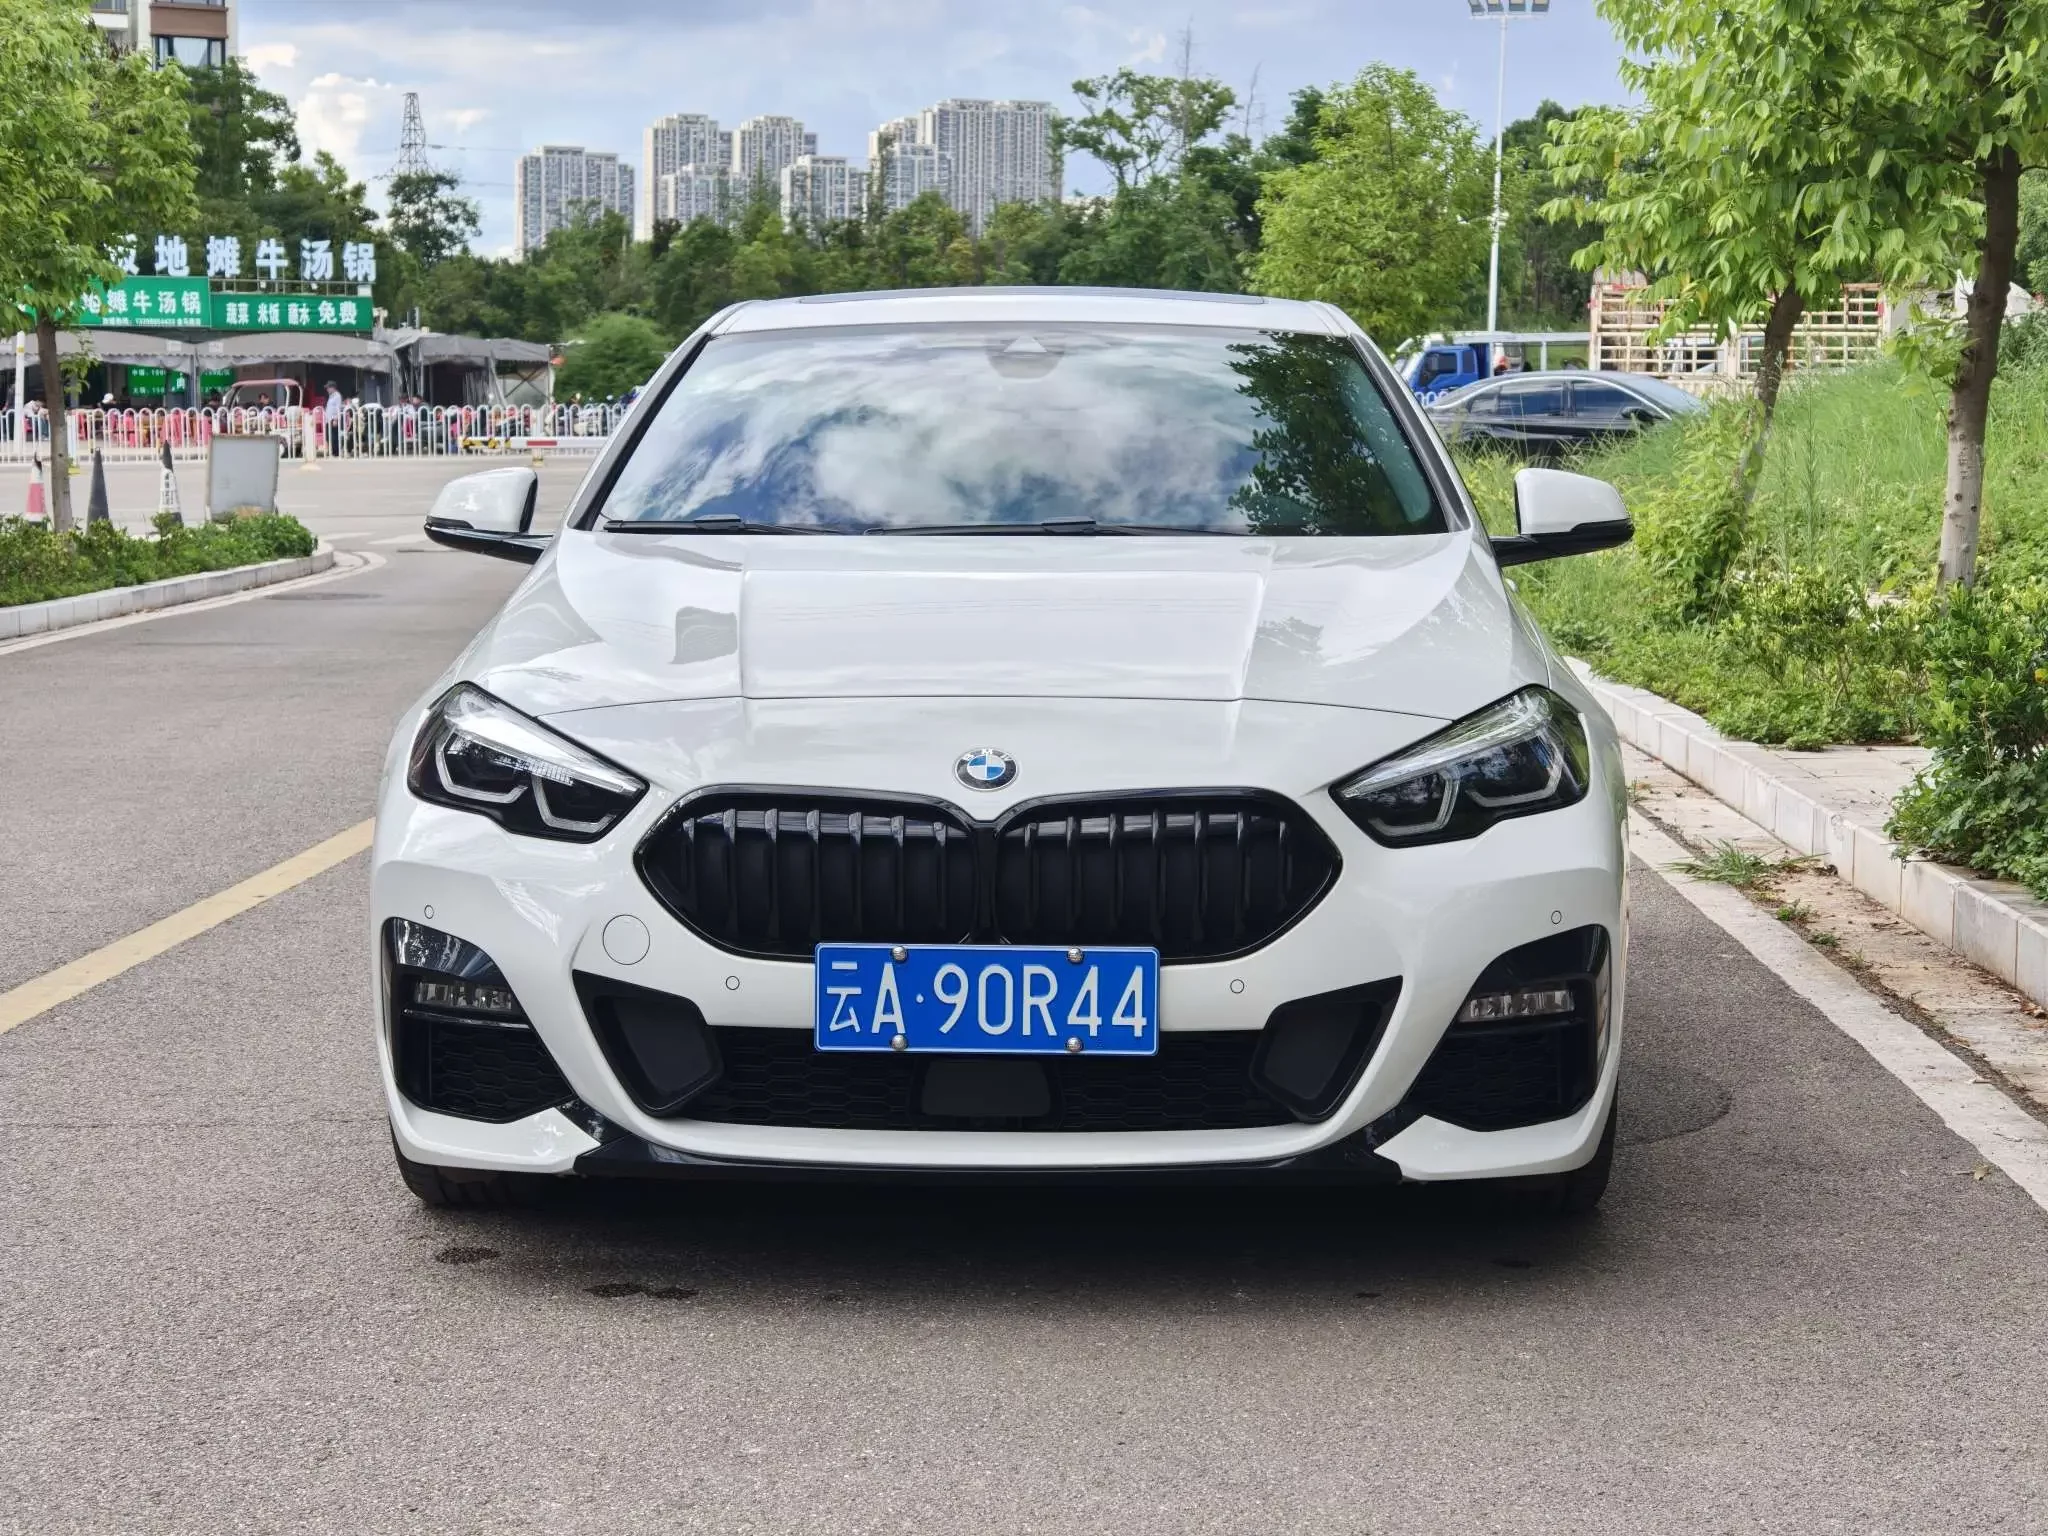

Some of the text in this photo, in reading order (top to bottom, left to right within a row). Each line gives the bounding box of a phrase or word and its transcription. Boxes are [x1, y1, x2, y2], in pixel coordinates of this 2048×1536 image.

[69, 289, 201, 315] 地摊牛汤锅
[257, 302, 280, 325] 米饭
[318, 300, 357, 325] 免费
